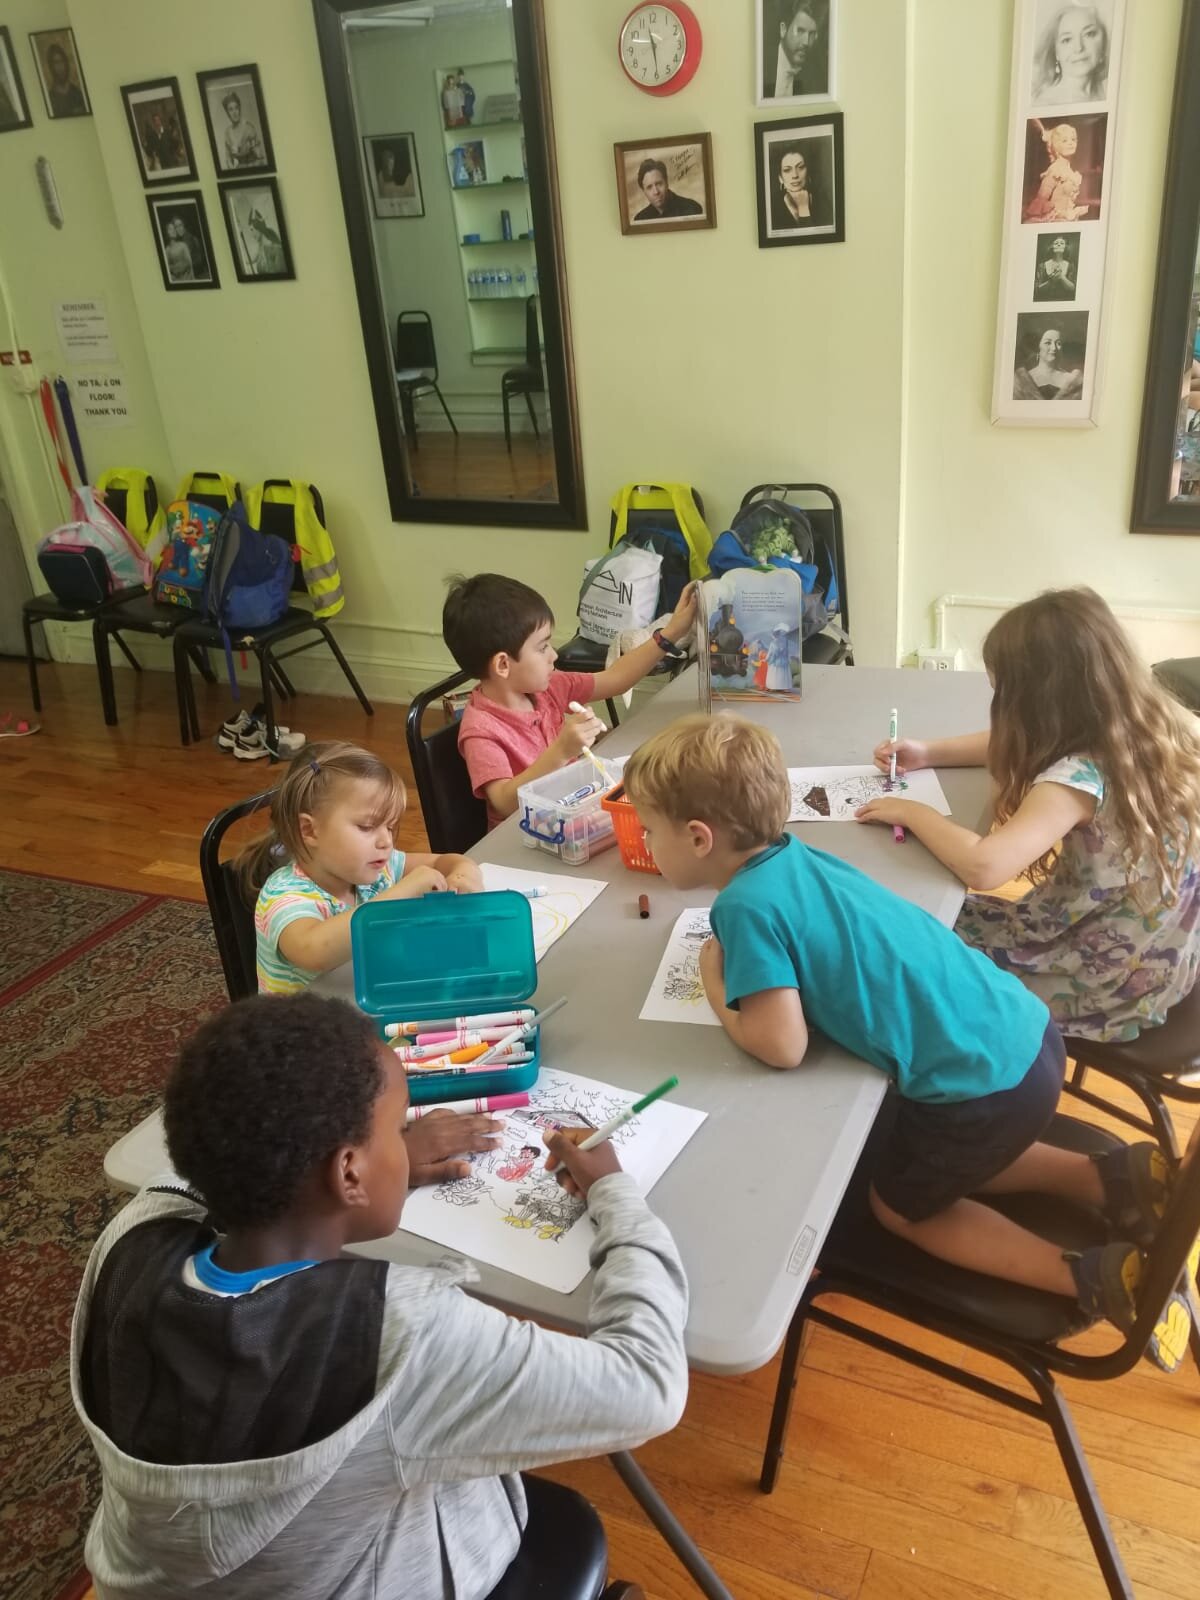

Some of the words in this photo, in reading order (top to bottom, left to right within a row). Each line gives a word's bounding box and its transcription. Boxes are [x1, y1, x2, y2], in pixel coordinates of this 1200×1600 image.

[649, 12, 656, 24] 12
[109, 378, 121, 386] ON
[85, 408, 110, 416] THANK
[111, 407, 127, 416] YOU
